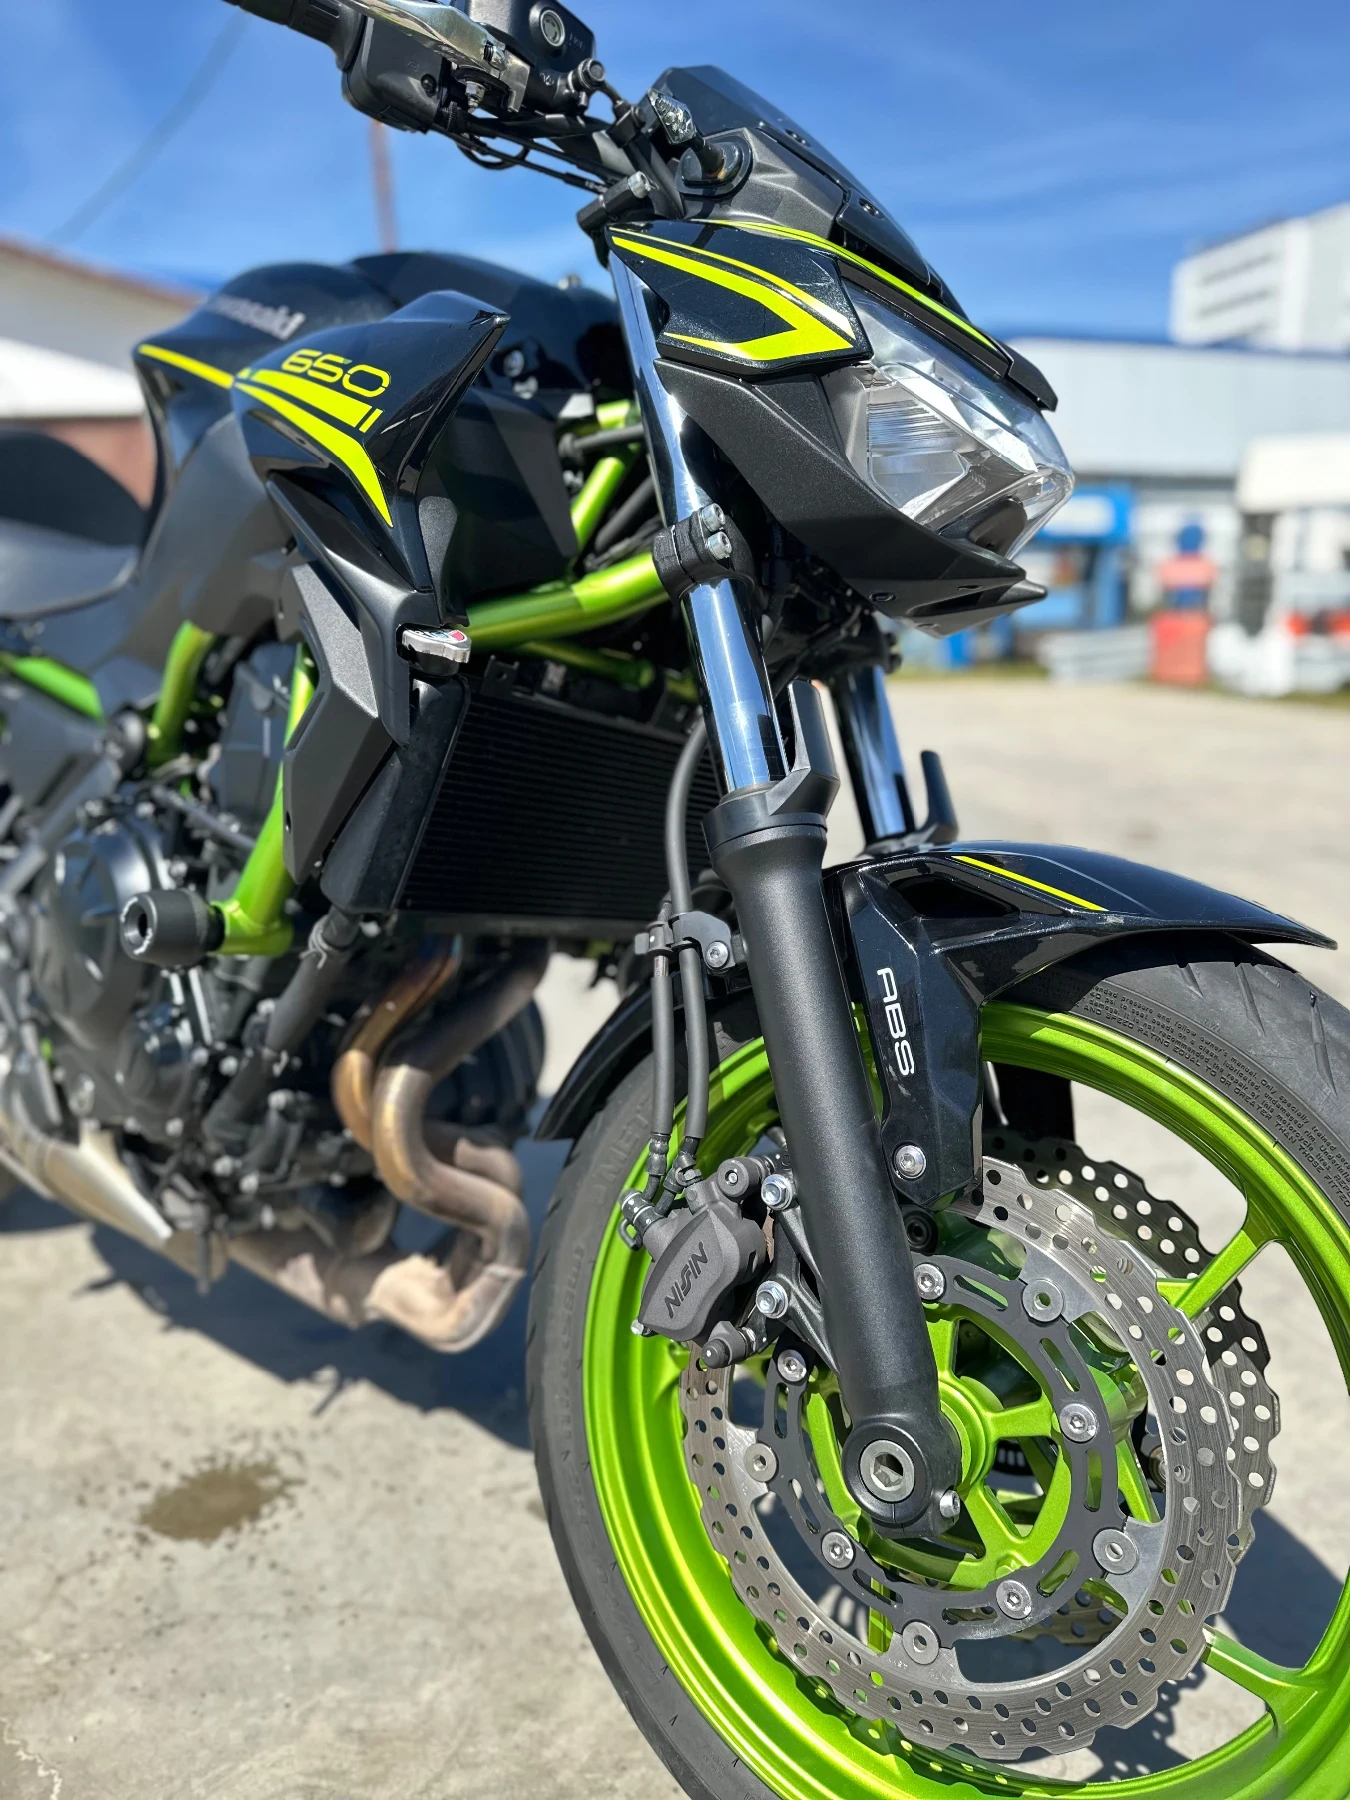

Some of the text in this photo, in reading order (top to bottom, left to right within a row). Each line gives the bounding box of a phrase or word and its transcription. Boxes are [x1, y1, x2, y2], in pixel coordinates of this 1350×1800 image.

[281, 348, 391, 398] 650
[876, 967, 915, 1076] ABS
[1105, 998, 1115, 1006] psi
[1178, 1033, 1187, 1041] on
[1264, 1093, 1304, 1128] undamaged
[1157, 1012, 1171, 1022] and
[1175, 1021, 1196, 1036] follow
[1200, 1036, 1228, 1057] owner's
[1261, 1079, 1276, 1095] Only
[1279, 1095, 1310, 1124] specially
[1312, 1125, 1337, 1151] trained
[1084, 1004, 1350, 1207] AND SPEED RATING EQUAL TO OR GREATER THAN THOSE FITTED
[1159, 1030, 1210, 1063] recommended
[1212, 1062, 1224, 1073] the
[1227, 1073, 1248, 1091] repair
[1262, 1100, 1274, 1113] this
[1277, 1114, 1314, 1151] motorcycle
